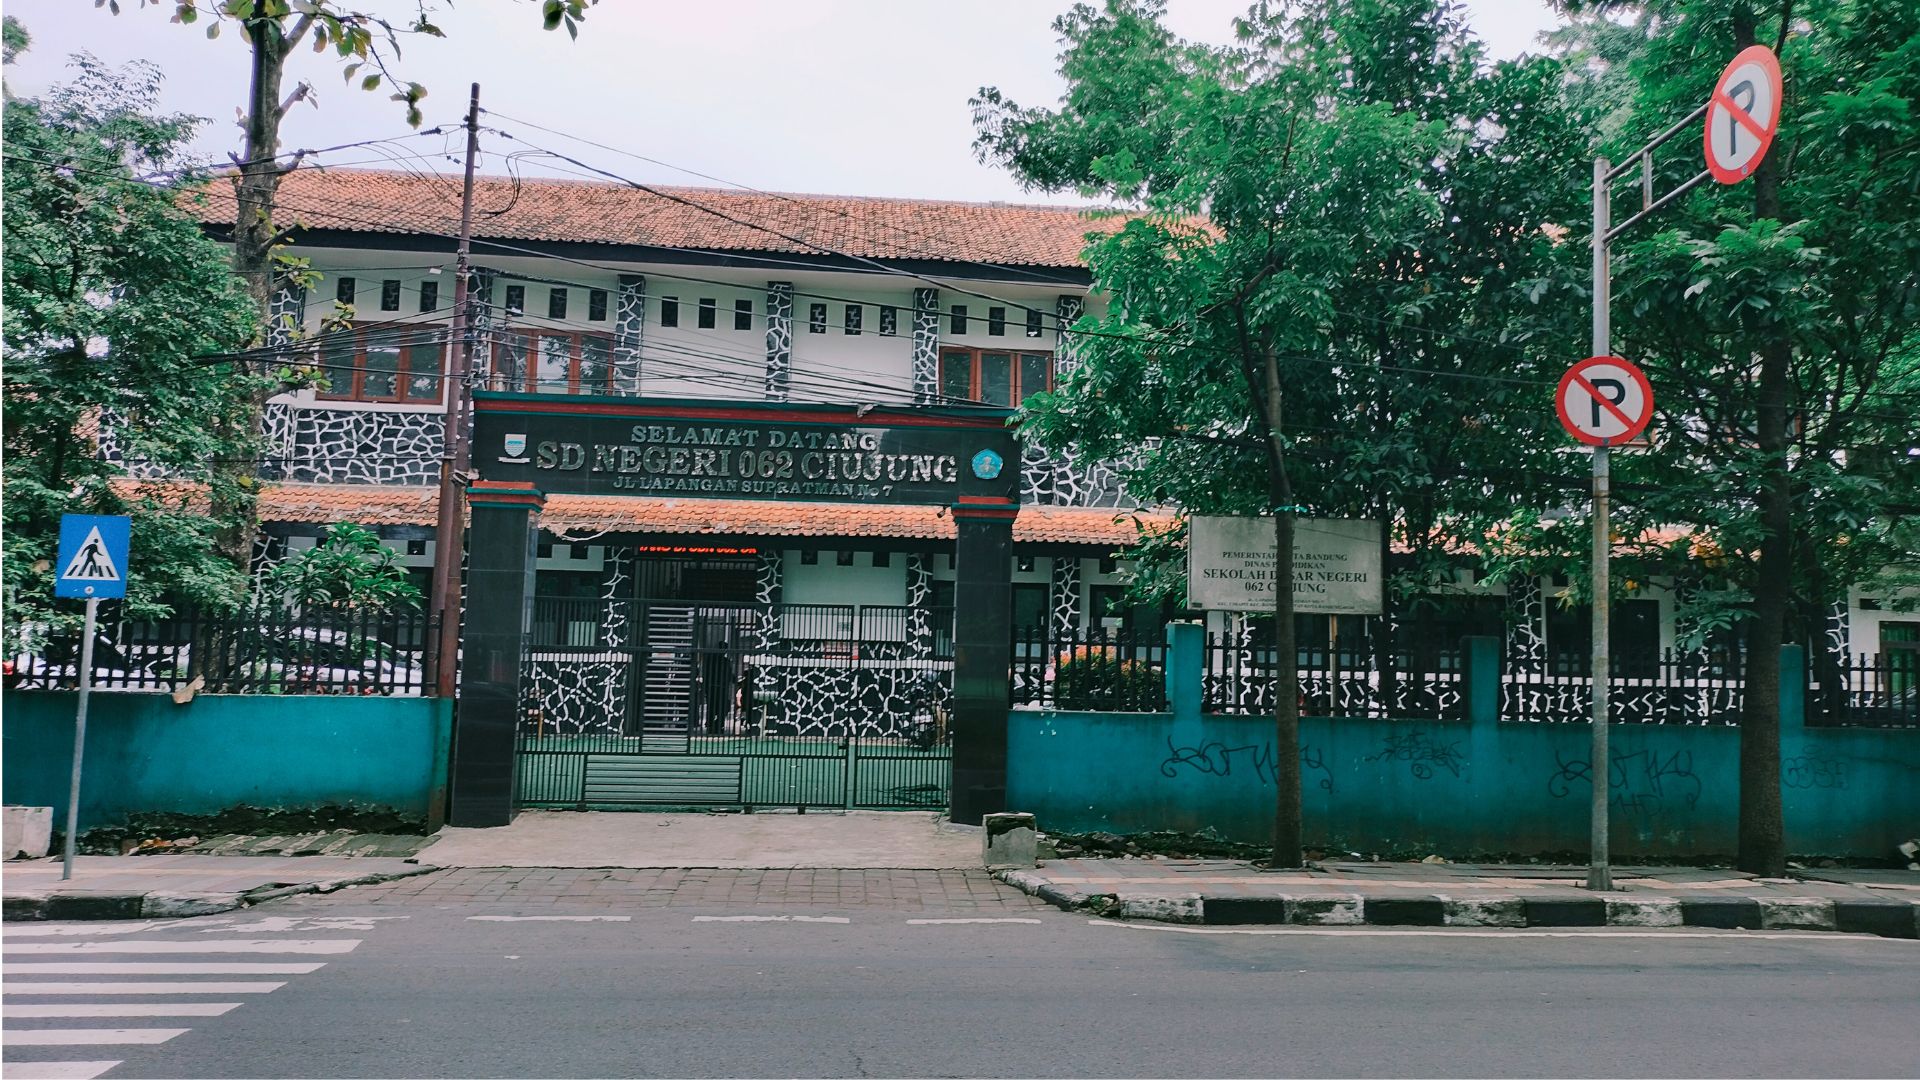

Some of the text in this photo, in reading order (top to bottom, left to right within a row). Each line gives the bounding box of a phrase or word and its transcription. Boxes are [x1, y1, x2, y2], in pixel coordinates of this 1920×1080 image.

[1729, 79, 1755, 157] P
[1590, 378, 1626, 428] P
[631, 425, 877, 451] SELAMAT DATANG
[536, 441, 958, 482] SD NEGERI 062 CIUJUNG
[640, 477, 737, 492] LAPANGAN
[741, 481, 854, 496] SUPRATMAN
[882, 484, 893, 497] 7
[1203, 568, 1367, 583] SEKOLAH DAR NEGERI
[1244, 560, 1326, 569] DINAS PIDIKAN
[1245, 582, 1326, 593] 062 CJUNG
